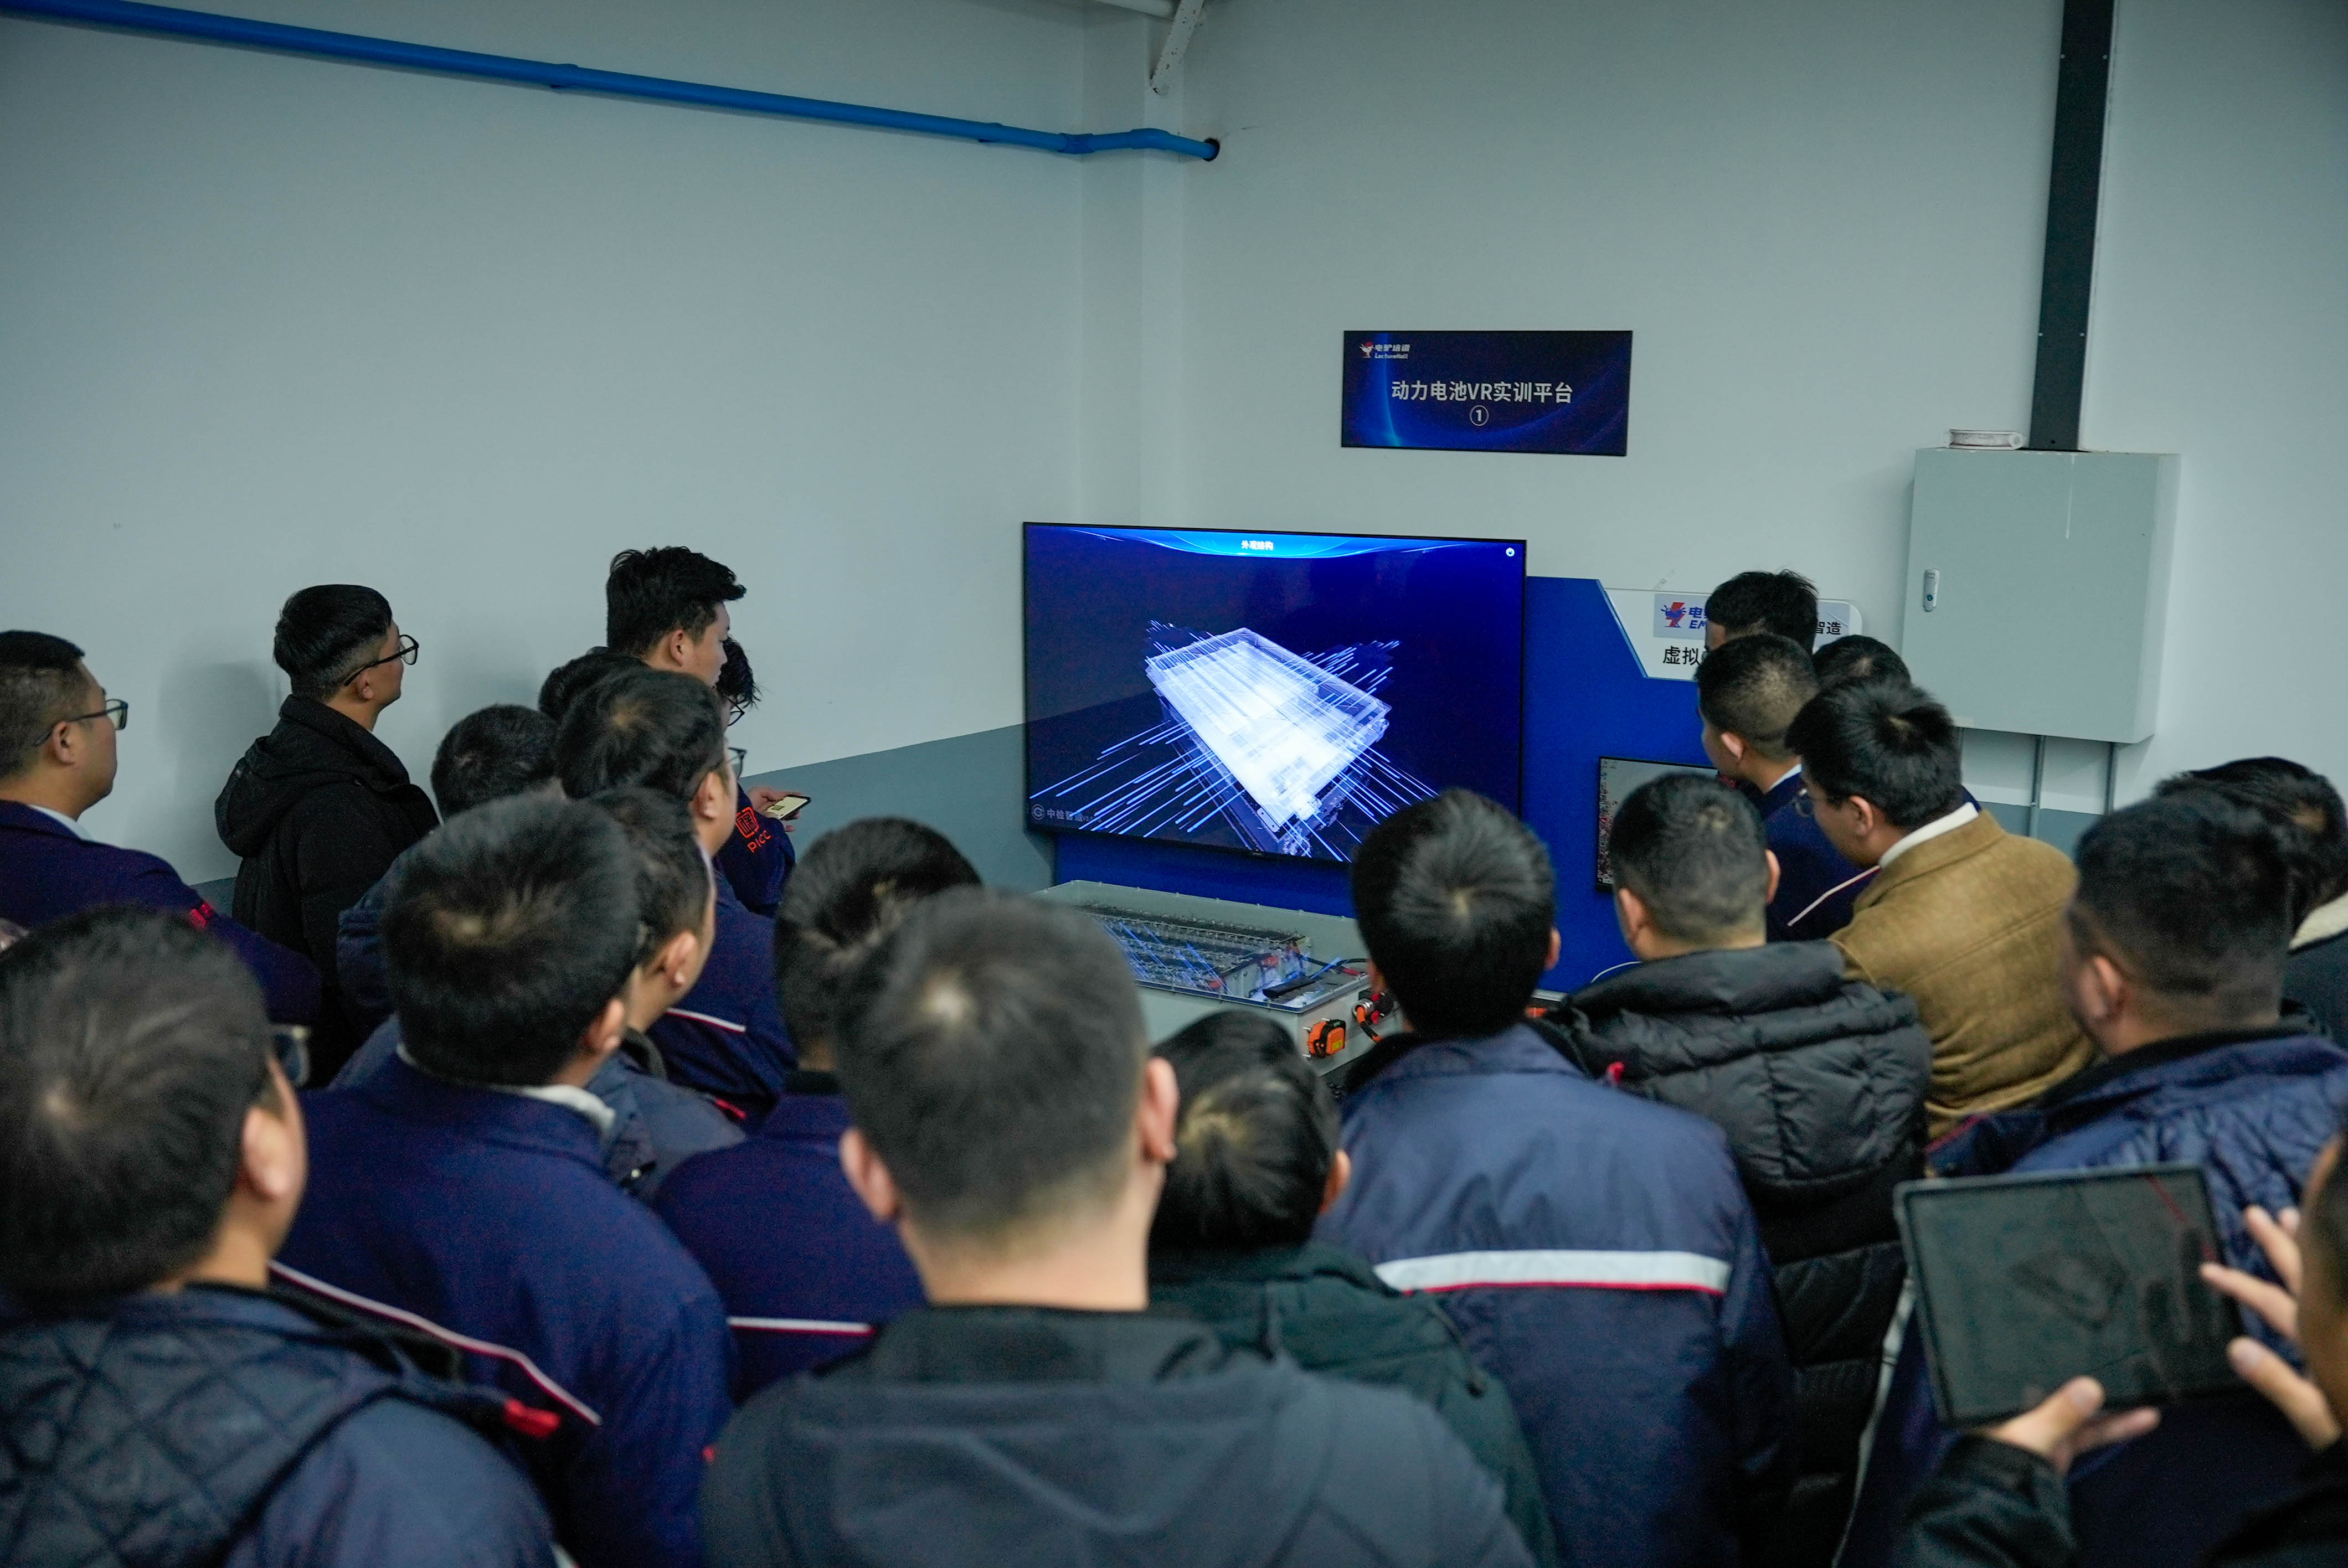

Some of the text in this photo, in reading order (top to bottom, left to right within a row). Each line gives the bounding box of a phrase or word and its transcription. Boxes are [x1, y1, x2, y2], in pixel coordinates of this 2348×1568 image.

[1392, 380, 1573, 404] 动力电池VR实训平台
[748, 830, 771, 853] PICC
